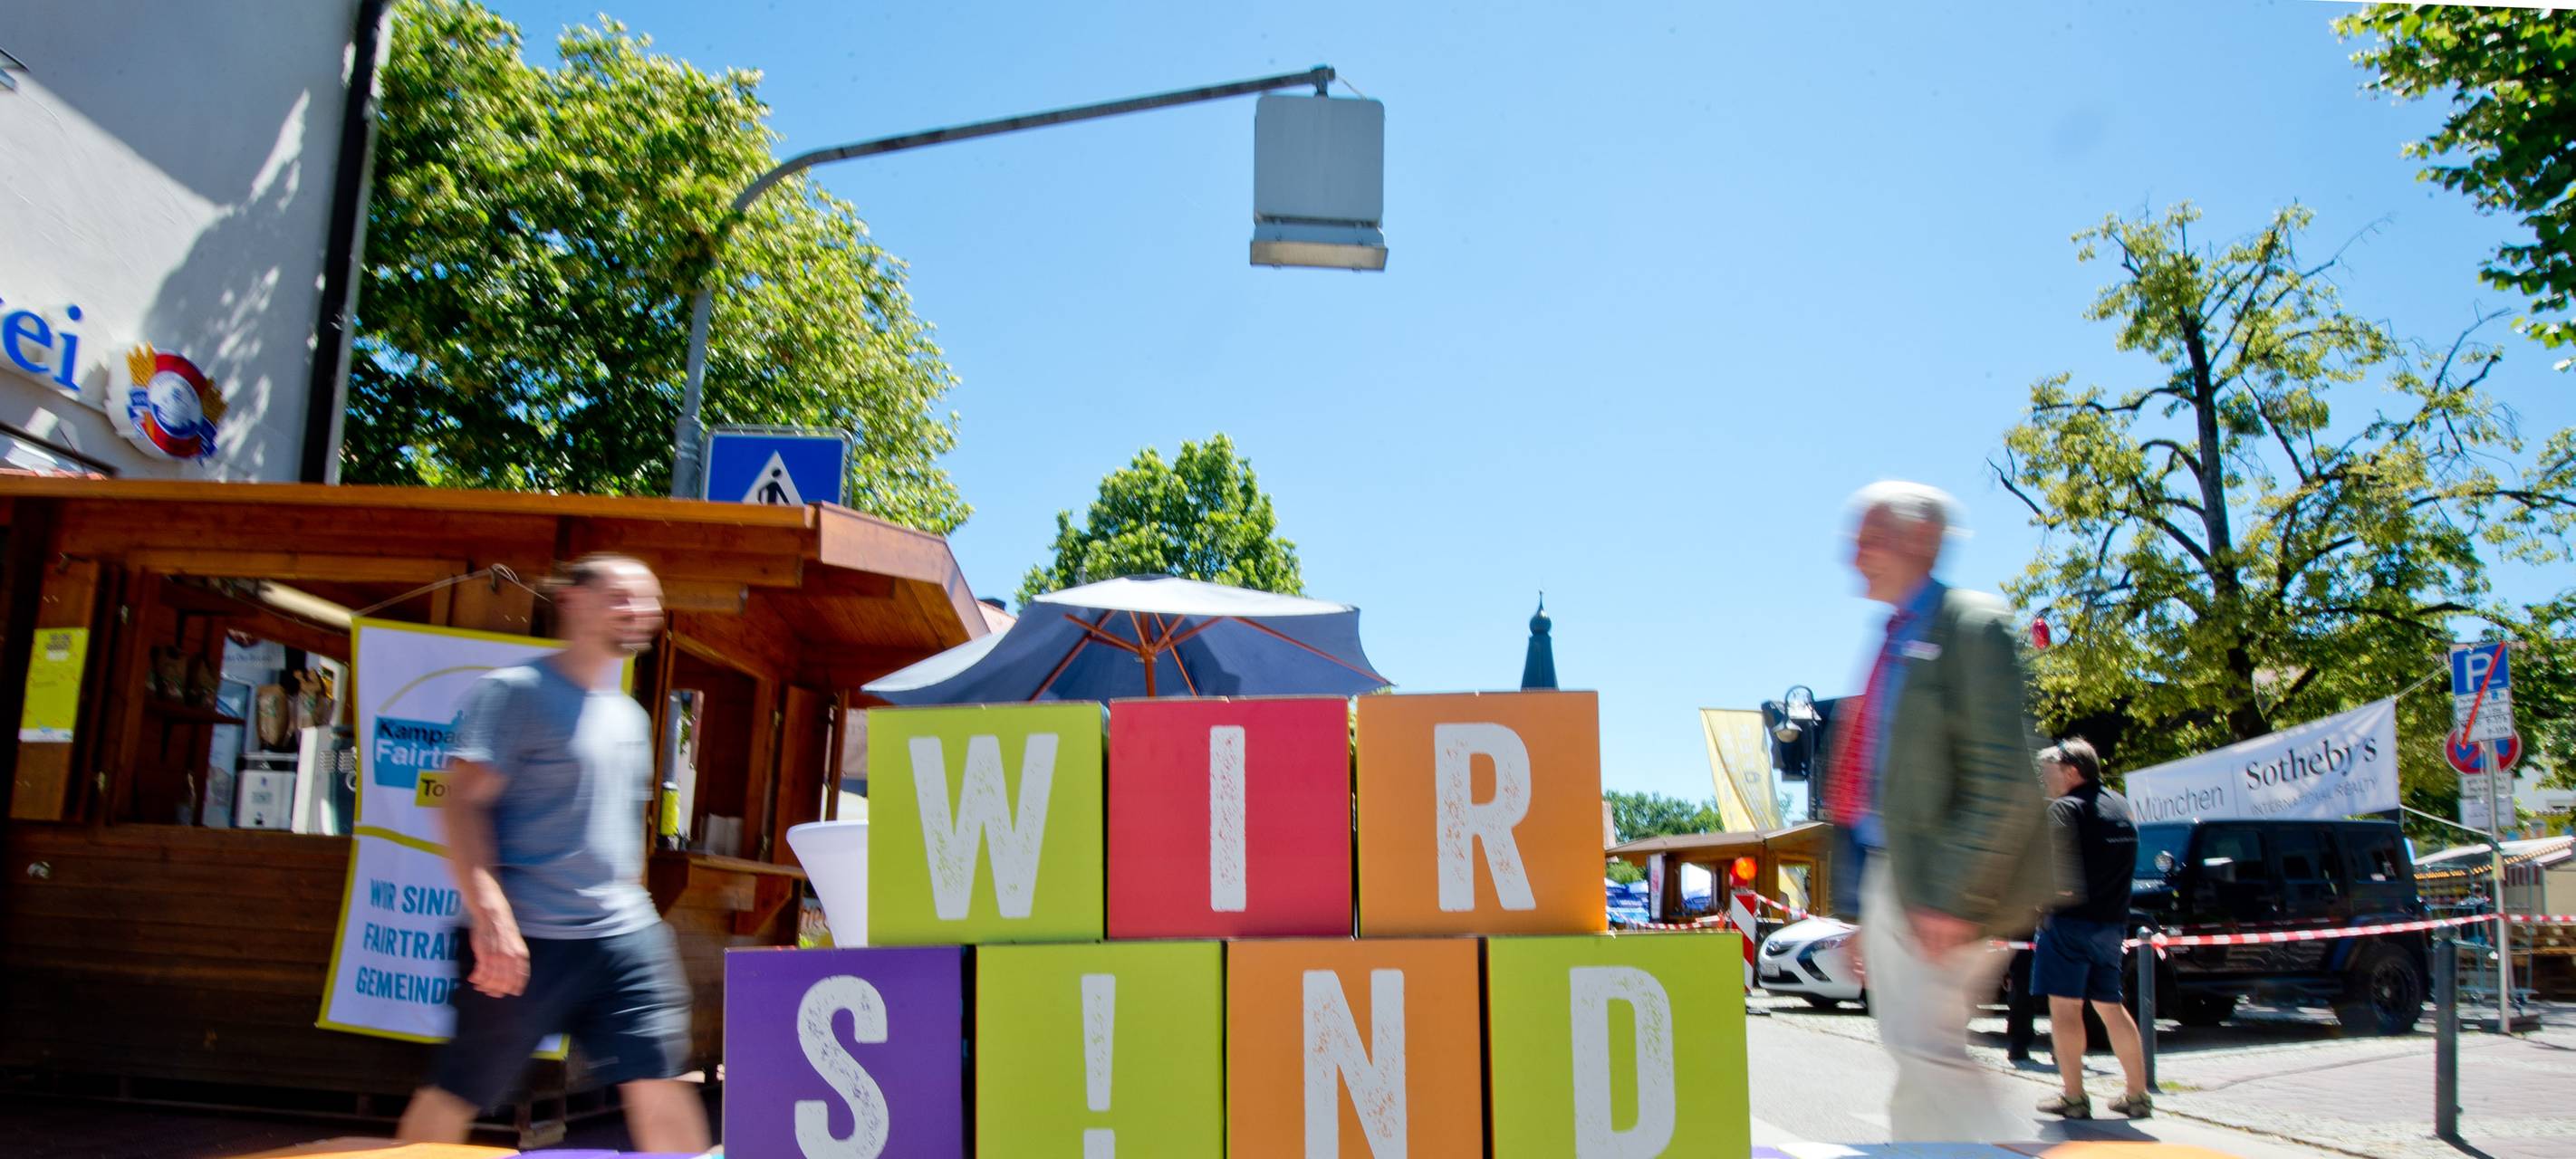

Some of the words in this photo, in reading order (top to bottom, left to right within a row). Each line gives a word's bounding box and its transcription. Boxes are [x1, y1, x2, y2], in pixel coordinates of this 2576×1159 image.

[0, 297, 82, 391] ei
[2465, 653, 2494, 692] P
[420, 779, 452, 797] To
[2134, 785, 2225, 821] München
[908, 723, 1537, 921] WIR
[370, 878, 397, 912] WIR
[401, 885, 461, 916] SIND
